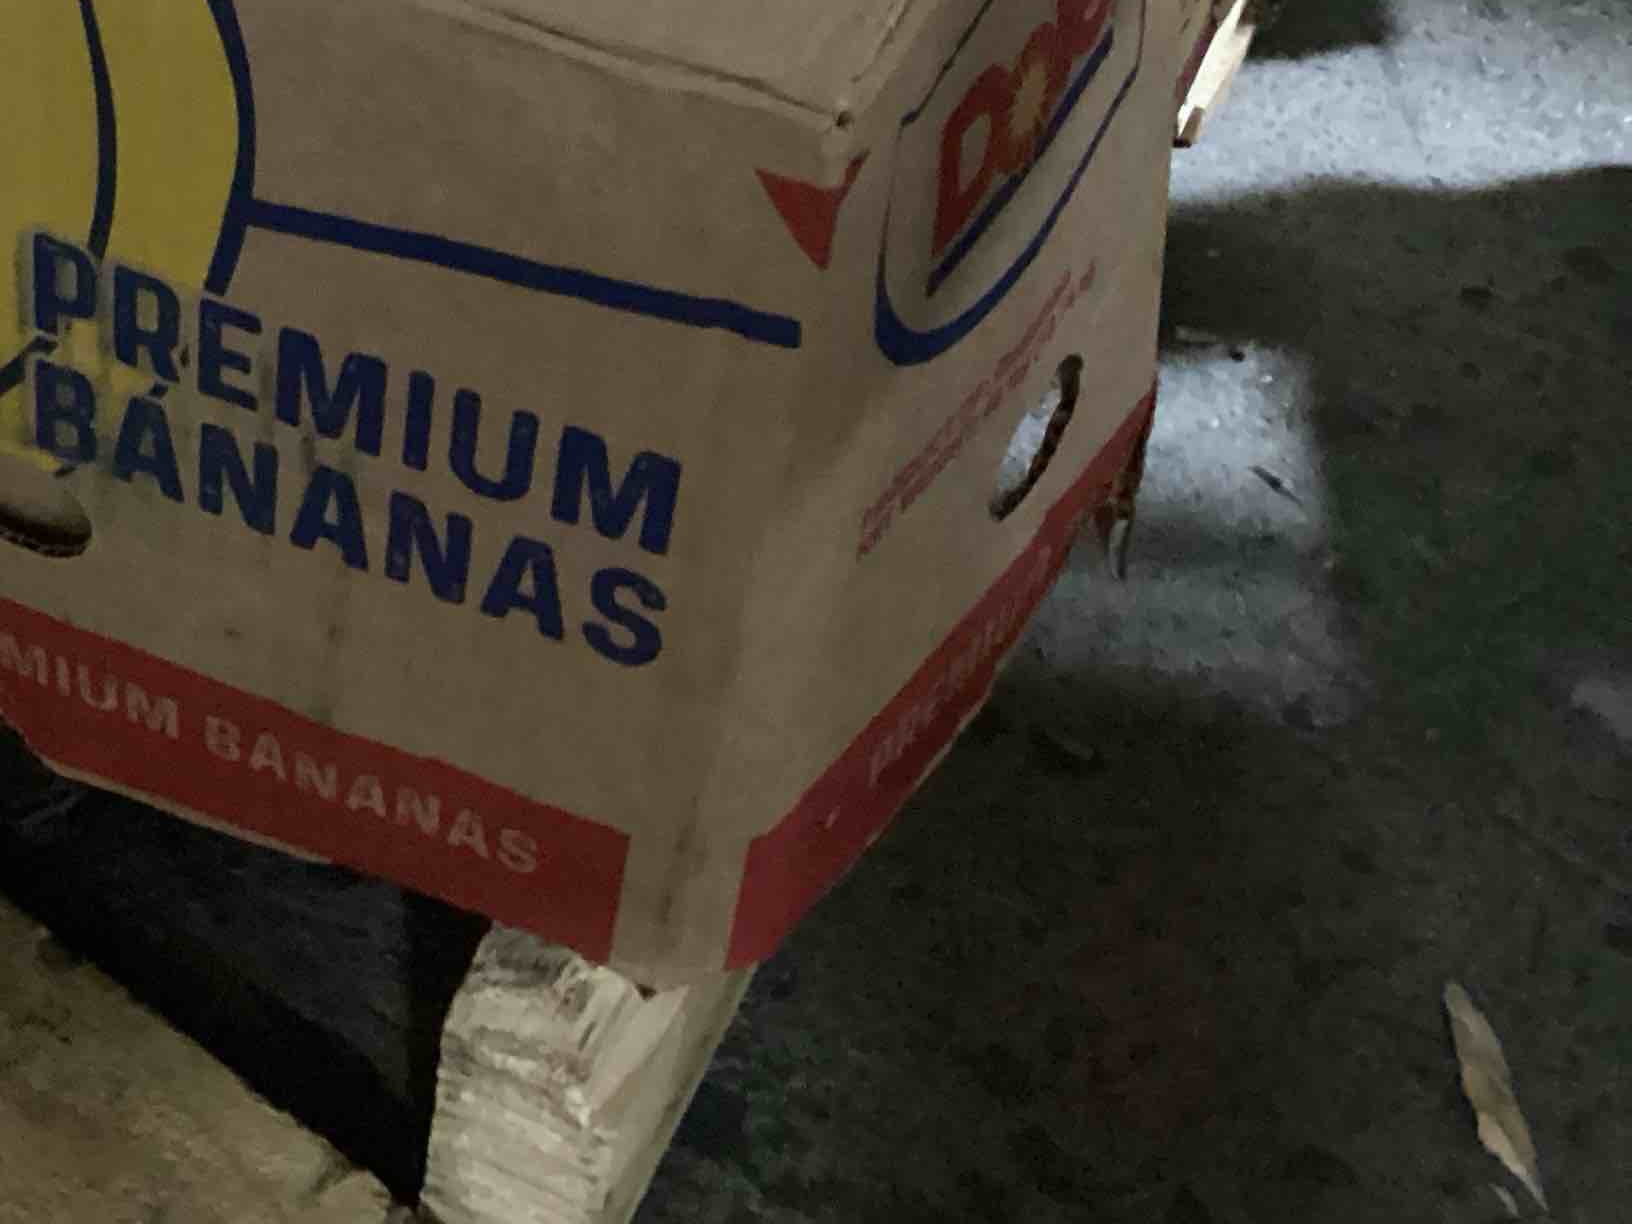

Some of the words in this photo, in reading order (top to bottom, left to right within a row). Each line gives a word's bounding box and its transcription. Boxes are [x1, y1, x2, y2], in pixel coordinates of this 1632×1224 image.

[31, 231, 683, 557] PREMIUM
[31, 358, 667, 669] BANANAS
[203, 713, 543, 875] BANANAS
